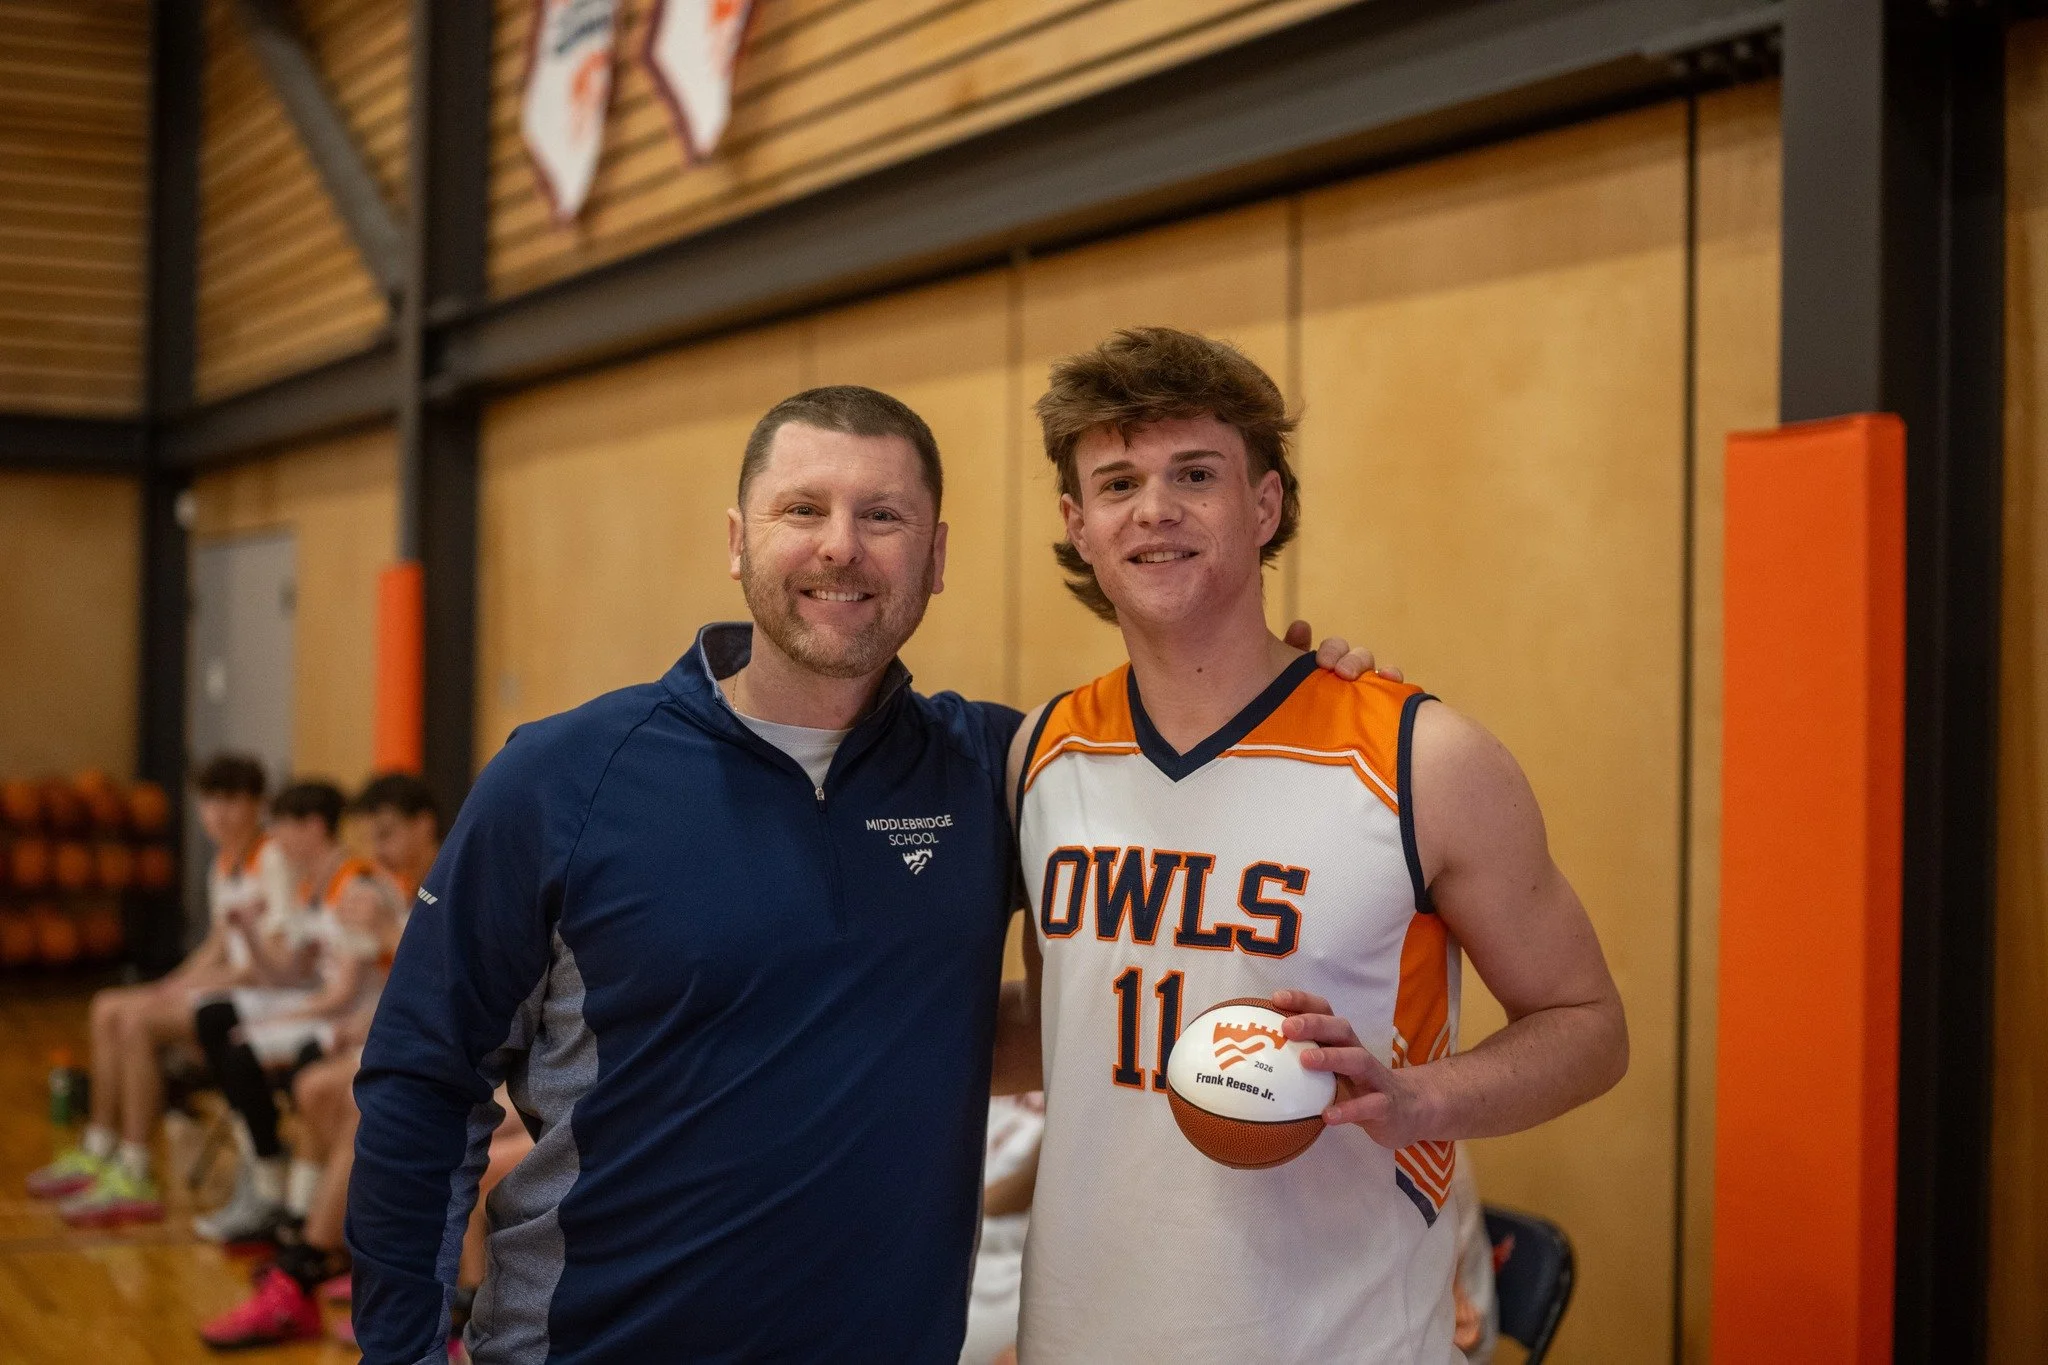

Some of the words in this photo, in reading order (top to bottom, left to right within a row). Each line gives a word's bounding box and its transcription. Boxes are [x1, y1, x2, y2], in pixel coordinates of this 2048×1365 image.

[866, 814, 953, 831] MIDDLEBRIDGE
[888, 832, 939, 846] SCHOOL
[1040, 845, 1310, 960] OWLS
[1112, 966, 1185, 1095] 11
[1255, 1061, 1274, 1073] 2026
[1196, 1073, 1224, 1086] Frank
[1226, 1077, 1259, 1095] Reese
[1261, 1088, 1275, 1102] Jr.
